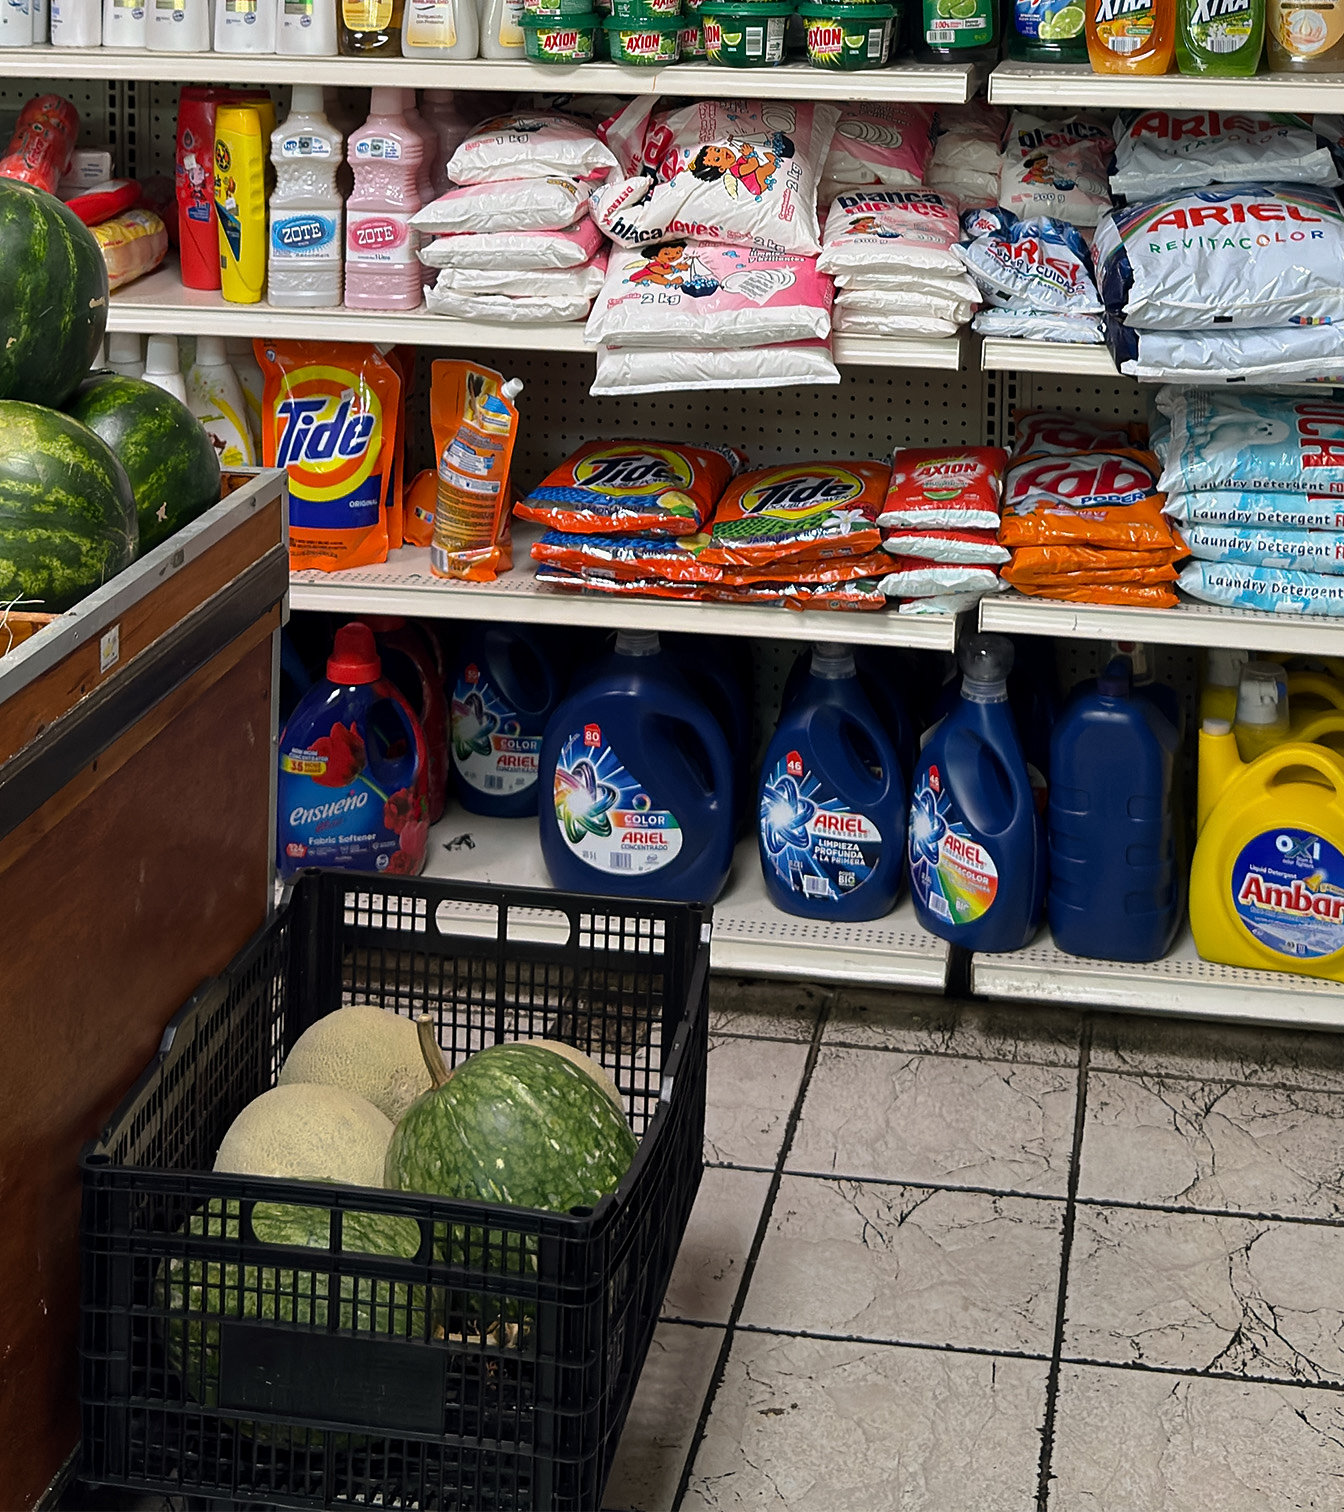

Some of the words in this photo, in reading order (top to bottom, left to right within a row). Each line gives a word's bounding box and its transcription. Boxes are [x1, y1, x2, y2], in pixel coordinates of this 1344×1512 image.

[544, 32, 578, 50] AXION
[625, 34, 660, 52] AXION
[495, 136, 503, 145] 1
[506, 133, 530, 147] kg
[1146, 203, 1321, 233] ARIEL
[281, 224, 322, 241] ZOTE
[356, 226, 395, 243] ZOTE
[1149, 229, 1325, 254] REVITACOLOR
[641, 293, 654, 305] 2
[659, 293, 680, 306] kg
[274, 396, 376, 468] Tide
[918, 463, 978, 476] AXION
[1009, 460, 1153, 500] Fab
[745, 477, 856, 517] Tide
[1081, 493, 1145, 505] PODER
[349, 499, 379, 510] ORIGINAL
[1192, 510, 1252, 522] Laundry
[1257, 512, 1330, 526] Detergent
[1193, 534, 1252, 552] Laundry
[1257, 540, 1331, 556] Detergent
[1208, 574, 1266, 594] Laundry
[1271, 583, 1344, 599] Detergent
[585, 731, 600, 741] 80
[499, 738, 539, 751] COLOR
[497, 755, 539, 767] ARIEL
[787, 761, 801, 770] 46
[624, 815, 666, 825] COLOR
[814, 814, 868, 833] ARIEL
[308, 836, 336, 845] Fabric
[338, 834, 376, 843] Softener
[622, 832, 668, 844] ARIEL
[818, 839, 859, 851] LIMPIEZA
[943, 833, 986, 867] ARIEL
[814, 847, 863, 859] PROFUNDA
[831, 856, 866, 866] PRIMERA
[1250, 864, 1266, 873] Liquid
[839, 875, 855, 885] BIO
